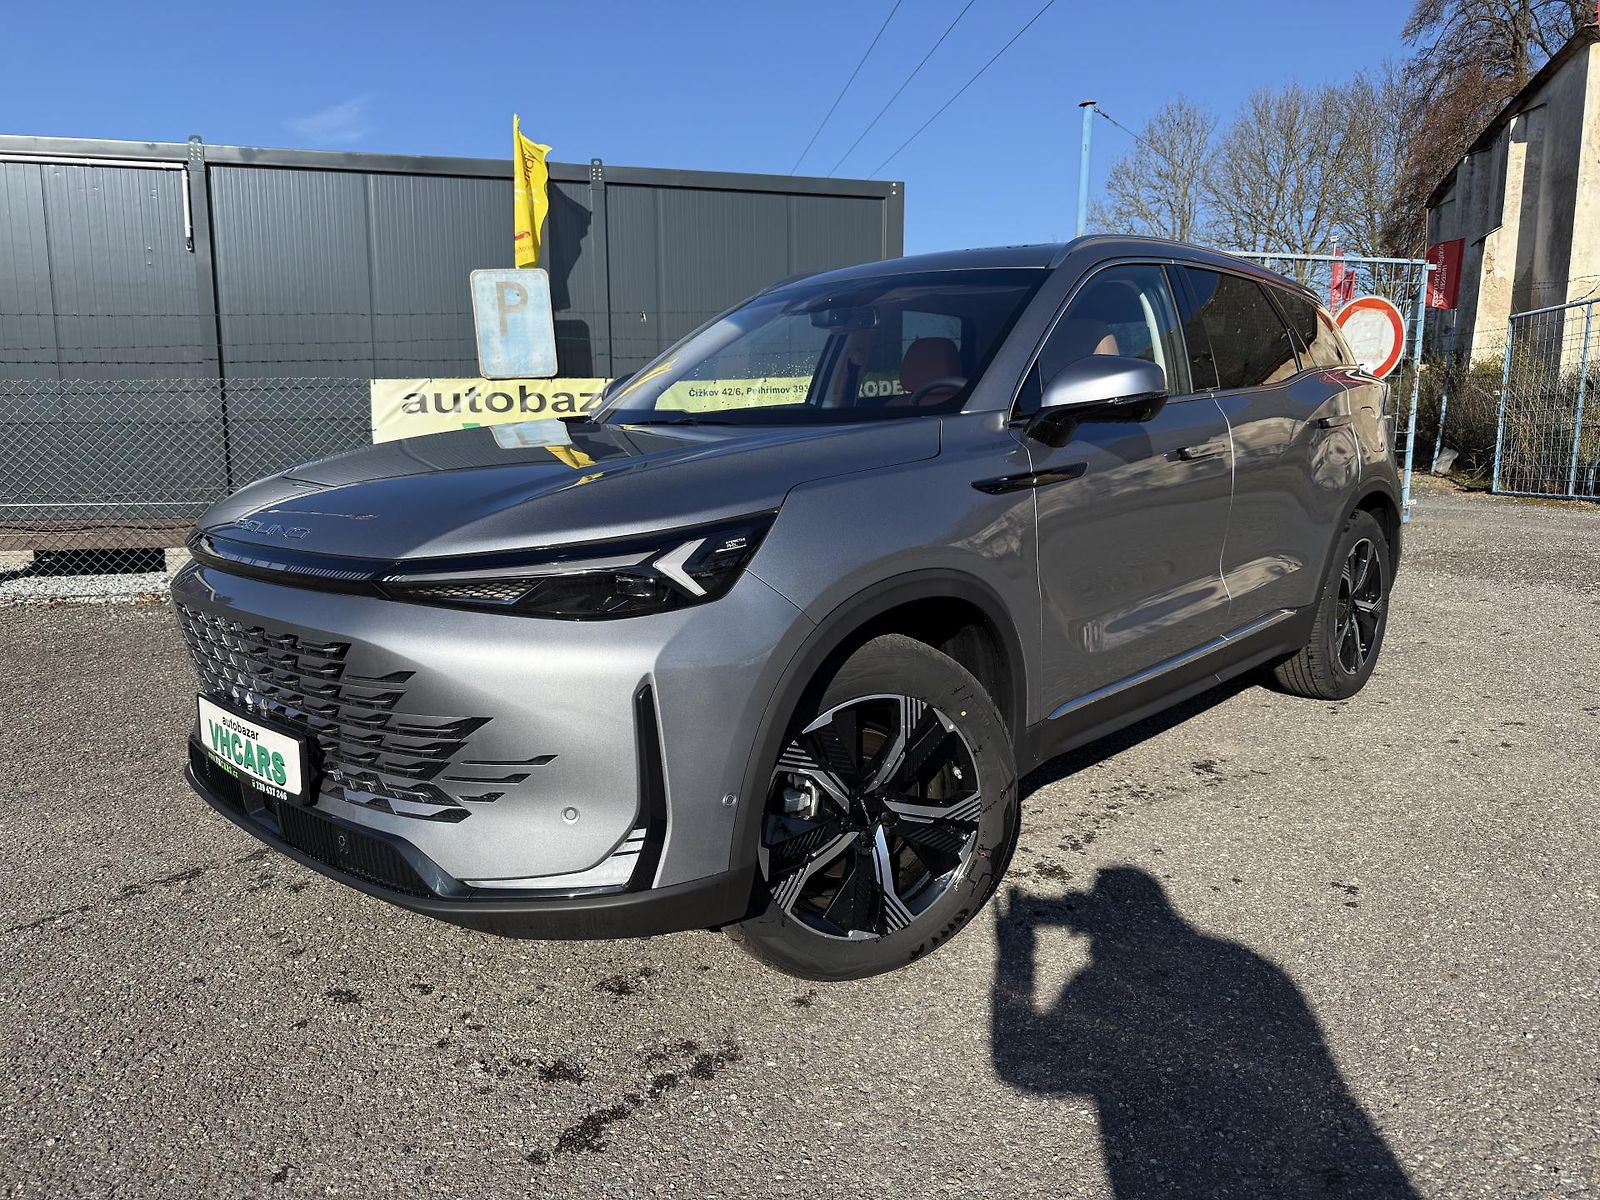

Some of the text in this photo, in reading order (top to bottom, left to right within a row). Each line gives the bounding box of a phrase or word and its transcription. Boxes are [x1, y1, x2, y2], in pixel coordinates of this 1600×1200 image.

[496, 281, 528, 337] P
[721, 387, 744, 396] 42/6,
[858, 380, 912, 398] ODE
[222, 716, 260, 741] autobazar
[208, 718, 287, 787] VHCARS
